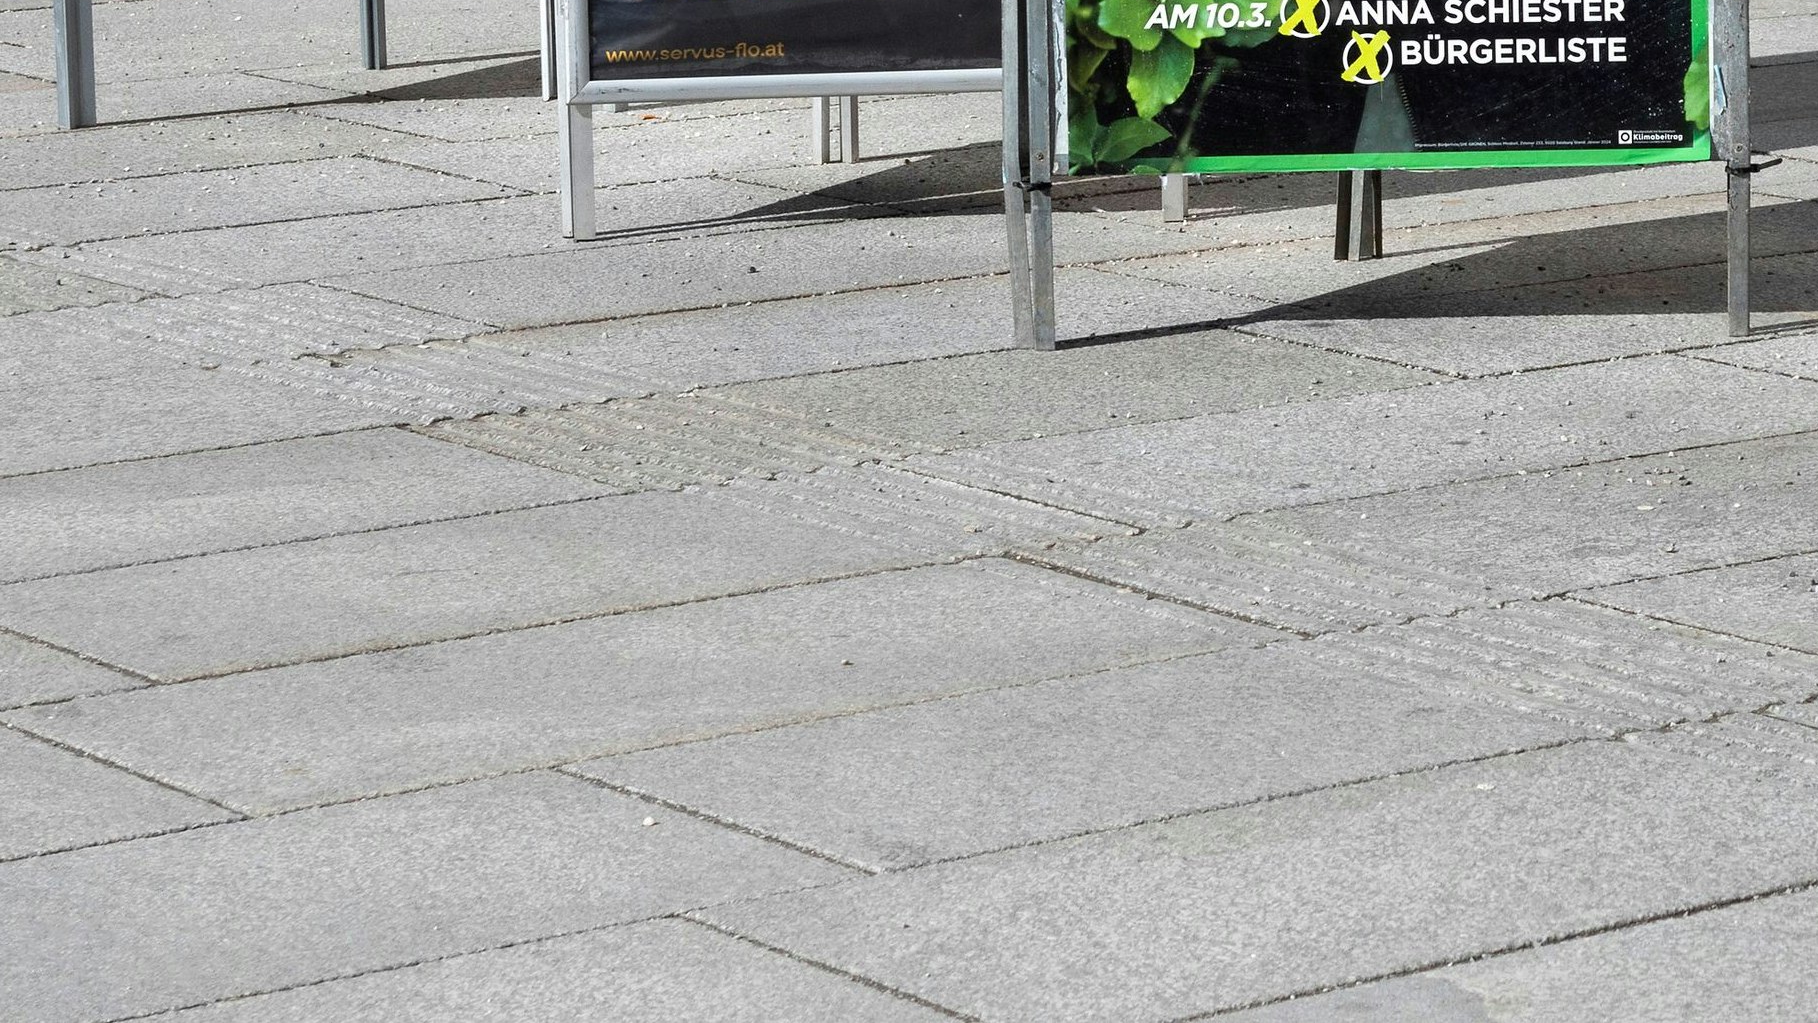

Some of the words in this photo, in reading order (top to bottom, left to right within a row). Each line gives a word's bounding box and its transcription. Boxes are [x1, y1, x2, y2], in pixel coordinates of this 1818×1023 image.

[1144, 0, 1197, 30] AM
[1204, 1, 1273, 30] 10.3.
[605, 41, 785, 63] www.servus-flo.at
[1401, 34, 1628, 66] BÜRGERLISTE
